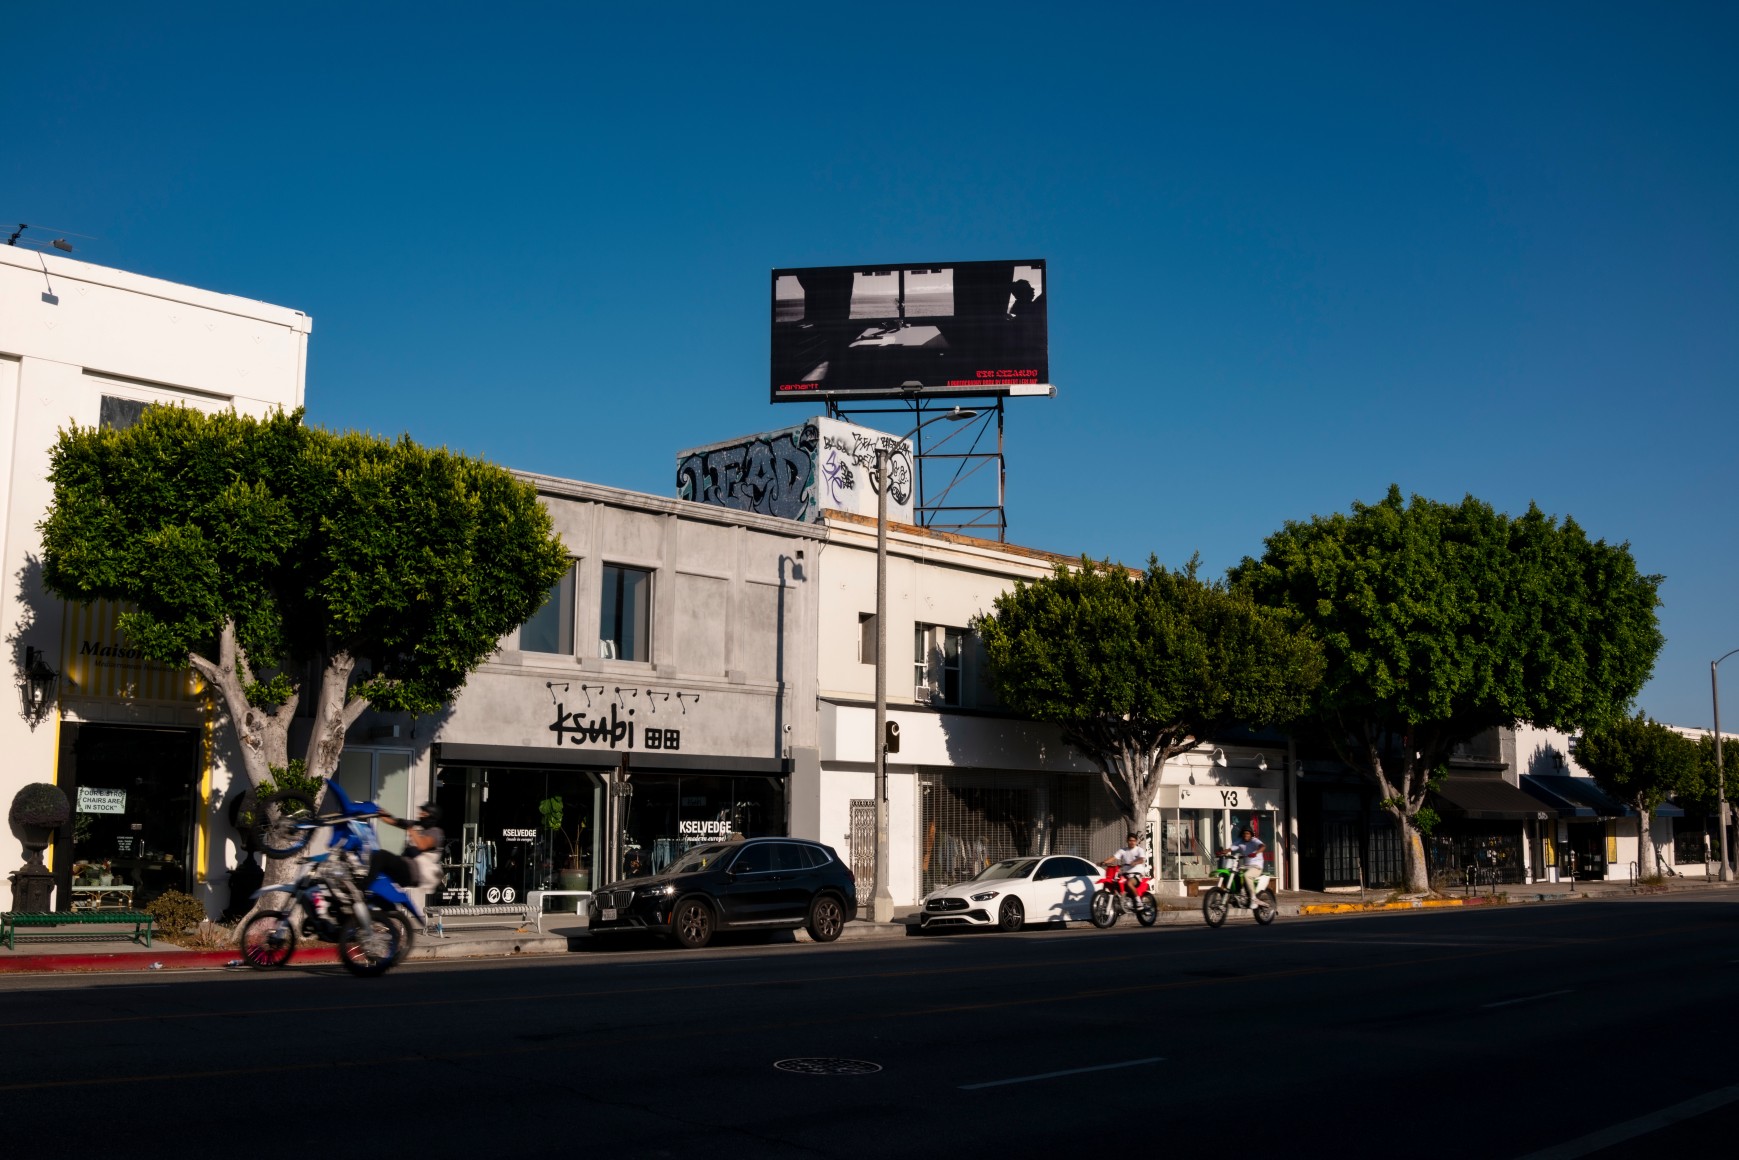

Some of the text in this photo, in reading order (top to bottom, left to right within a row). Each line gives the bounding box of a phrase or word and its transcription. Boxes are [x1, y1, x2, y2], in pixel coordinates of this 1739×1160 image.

[779, 383, 819, 391] carhartt
[679, 820, 732, 834] KSELVEDGE
[502, 828, 537, 837] KSELVEDGE
